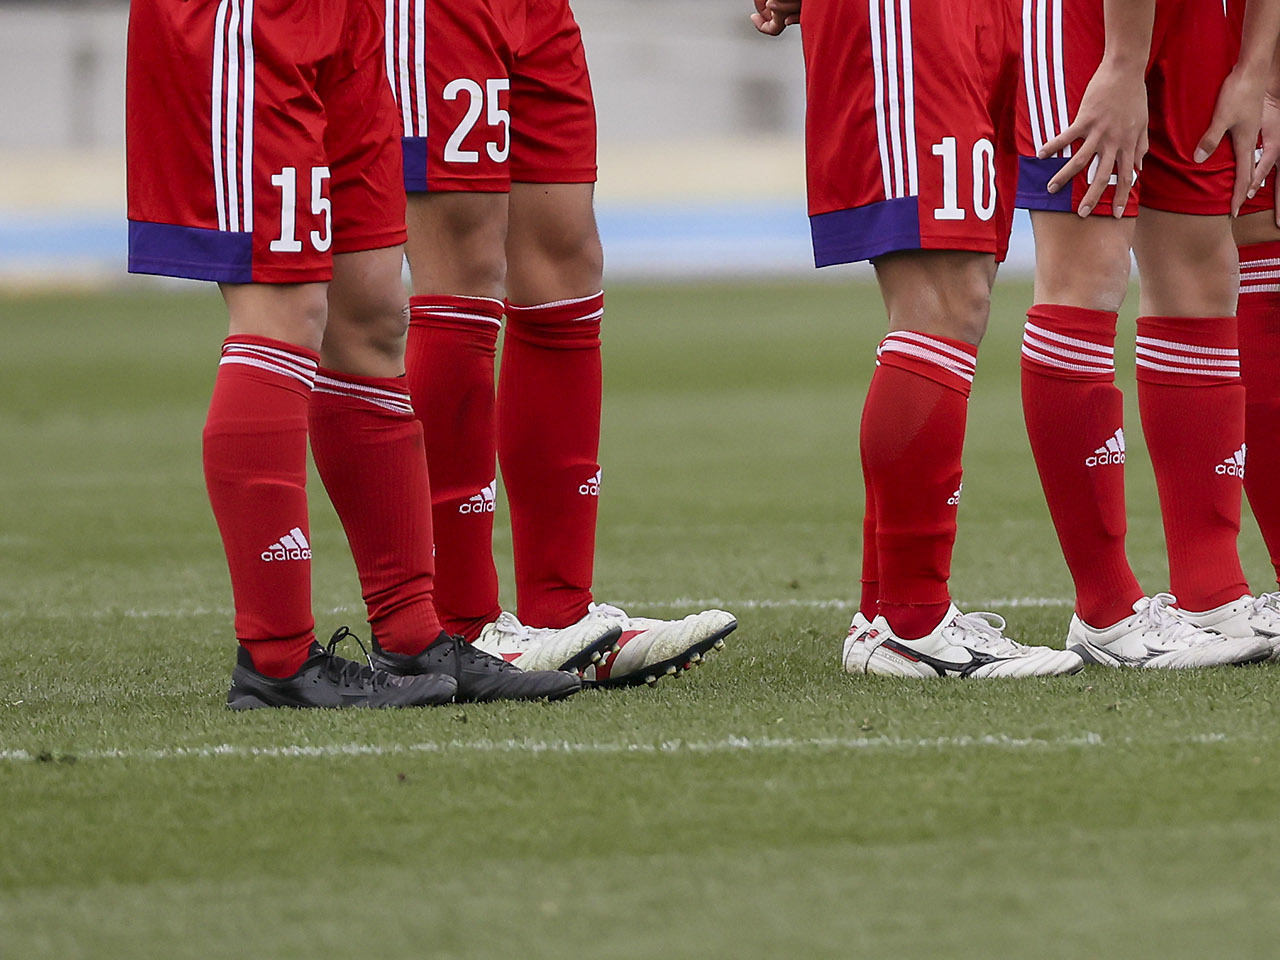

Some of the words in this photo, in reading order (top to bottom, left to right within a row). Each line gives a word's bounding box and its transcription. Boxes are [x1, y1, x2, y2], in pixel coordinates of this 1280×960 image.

[442, 77, 511, 163] 25
[269, 166, 332, 253] 15
[931, 136, 997, 222] 10
[261, 547, 312, 562] adidas
